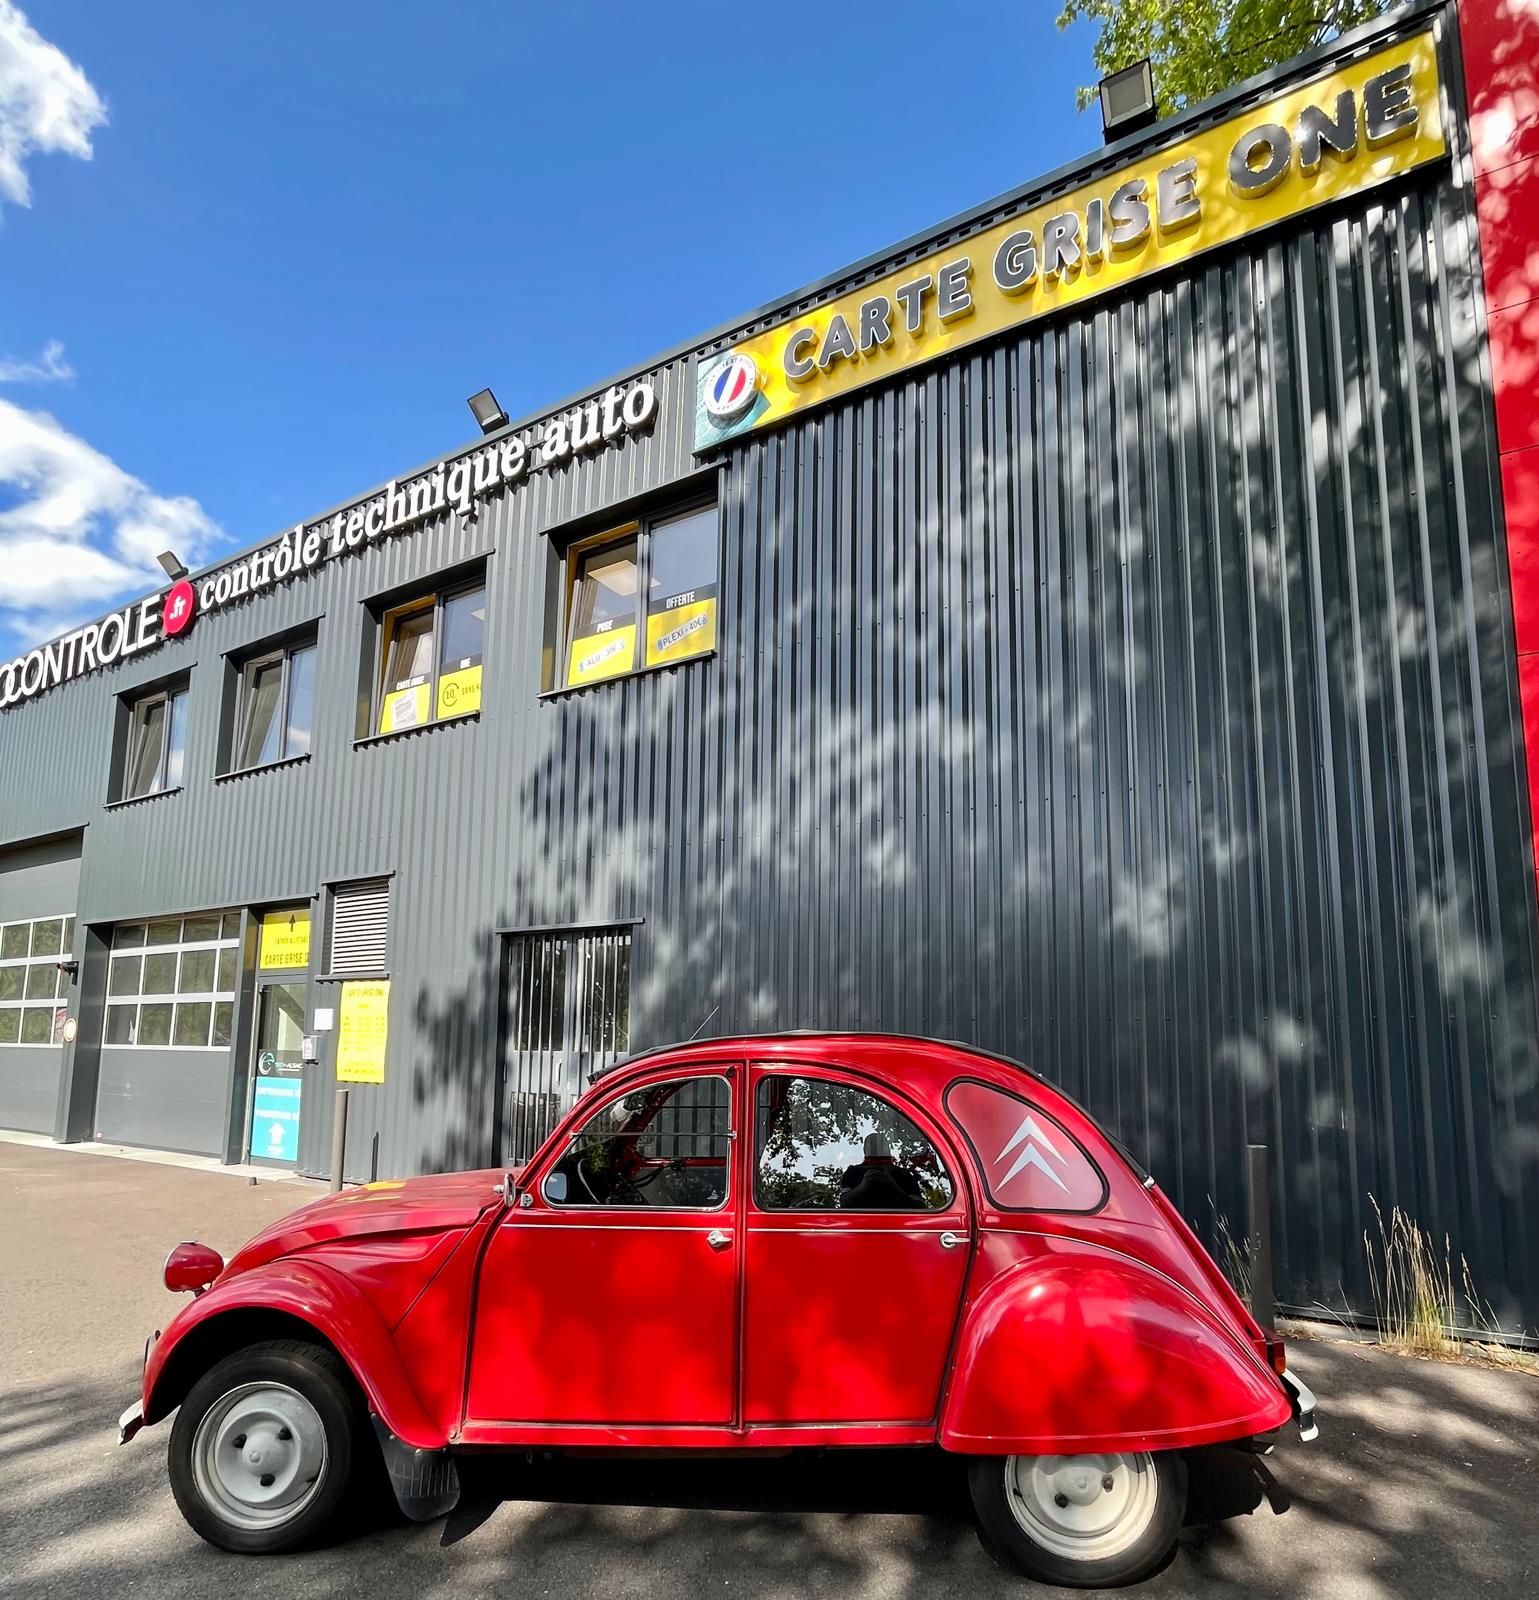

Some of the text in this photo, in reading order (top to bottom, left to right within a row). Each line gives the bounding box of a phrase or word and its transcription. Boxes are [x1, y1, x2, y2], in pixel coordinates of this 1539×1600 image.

[784, 63, 1420, 378] CARTE GRISE ONE
[200, 524, 321, 610] contrôle
[331, 435, 526, 553] technique
[541, 383, 654, 461] auto
[666, 591, 696, 609] OFFERTE
[596, 619, 614, 633] POSE
[663, 628, 684, 649] PLEXI
[587, 653, 601, 667] ALU
[265, 953, 284, 966] CARTE
